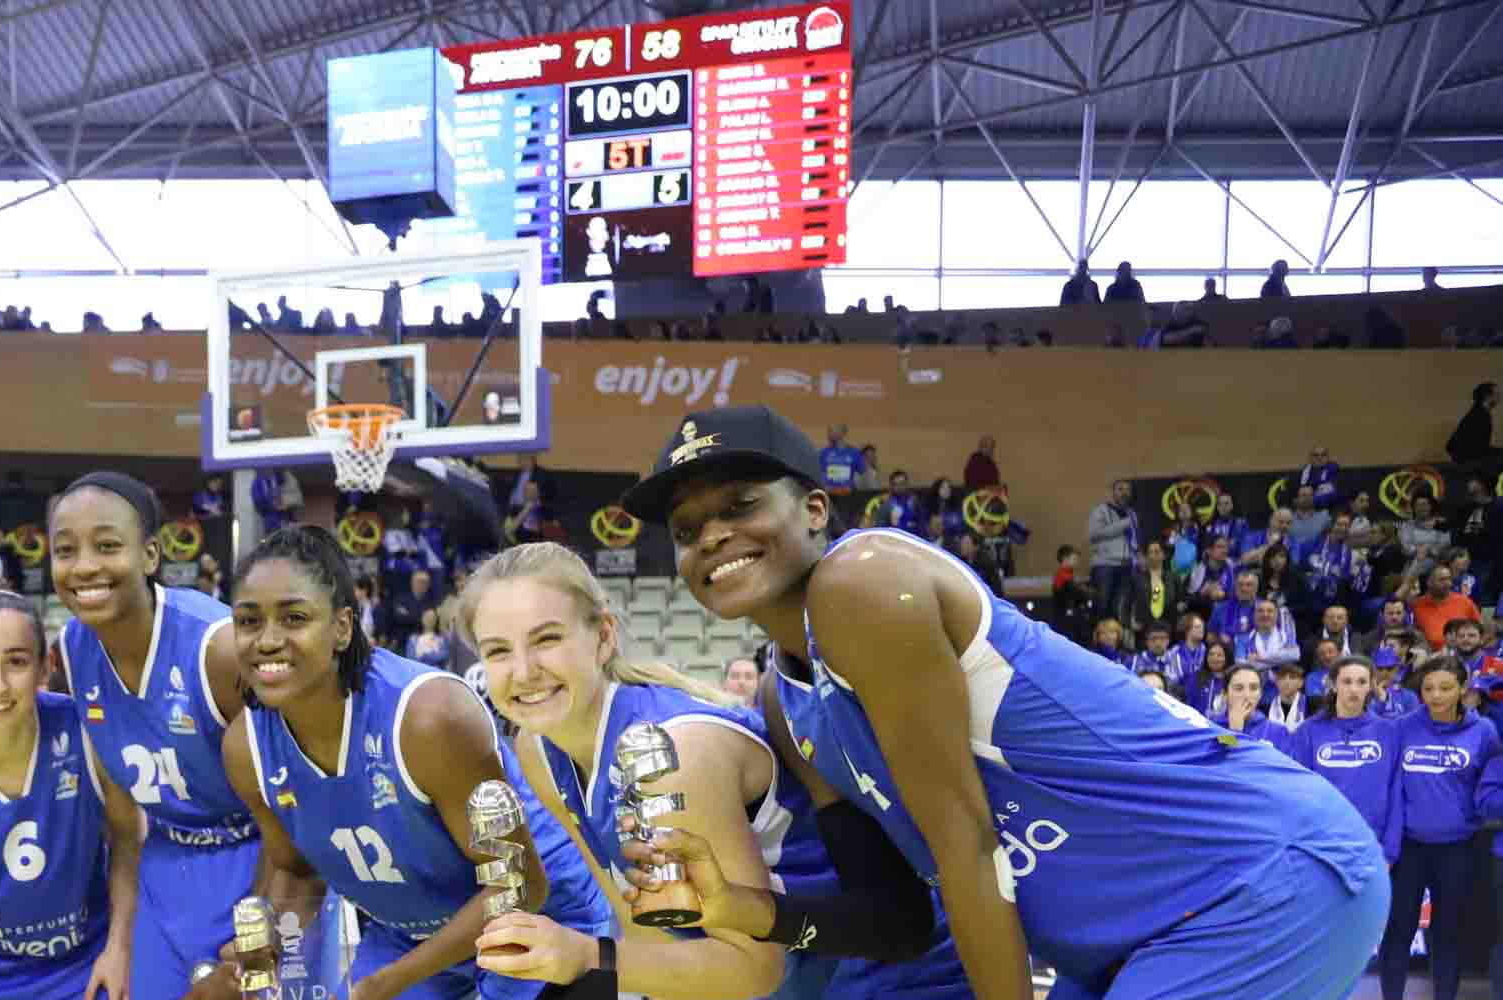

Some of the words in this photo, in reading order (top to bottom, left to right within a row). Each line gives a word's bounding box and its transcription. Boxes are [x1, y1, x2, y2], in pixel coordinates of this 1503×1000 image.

[574, 36, 613, 69] 76
[641, 29, 682, 61] 58
[576, 79, 681, 123] 10:00
[609, 138, 649, 169] 5T
[571, 179, 595, 210] 4
[658, 172, 682, 203] 5
[594, 356, 739, 405] enjoy!
[120, 743, 191, 804] 24
[3, 820, 47, 882] 6
[330, 825, 406, 882] 12
